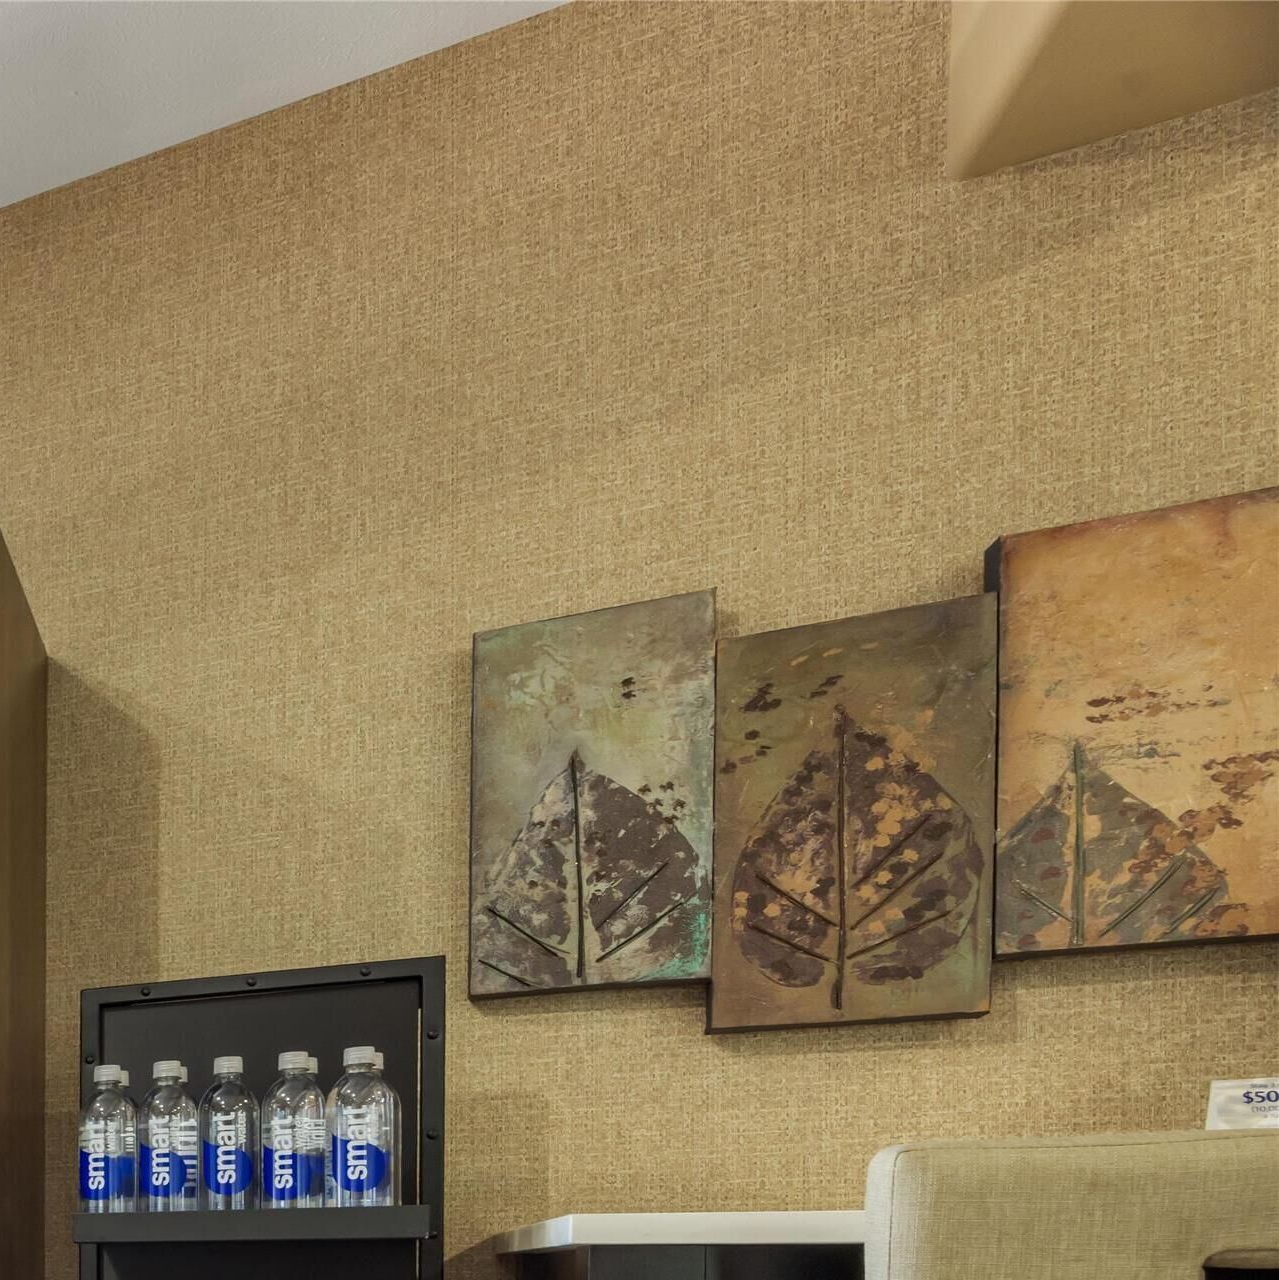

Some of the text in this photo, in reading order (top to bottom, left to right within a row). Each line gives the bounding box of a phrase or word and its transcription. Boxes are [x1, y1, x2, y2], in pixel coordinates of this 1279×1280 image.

[87, 1120, 105, 1190] smart
[152, 1114, 170, 1187] smart
[216, 1111, 236, 1184] smart
[274, 1115, 293, 1189] smart
[346, 1103, 368, 1181] smart
